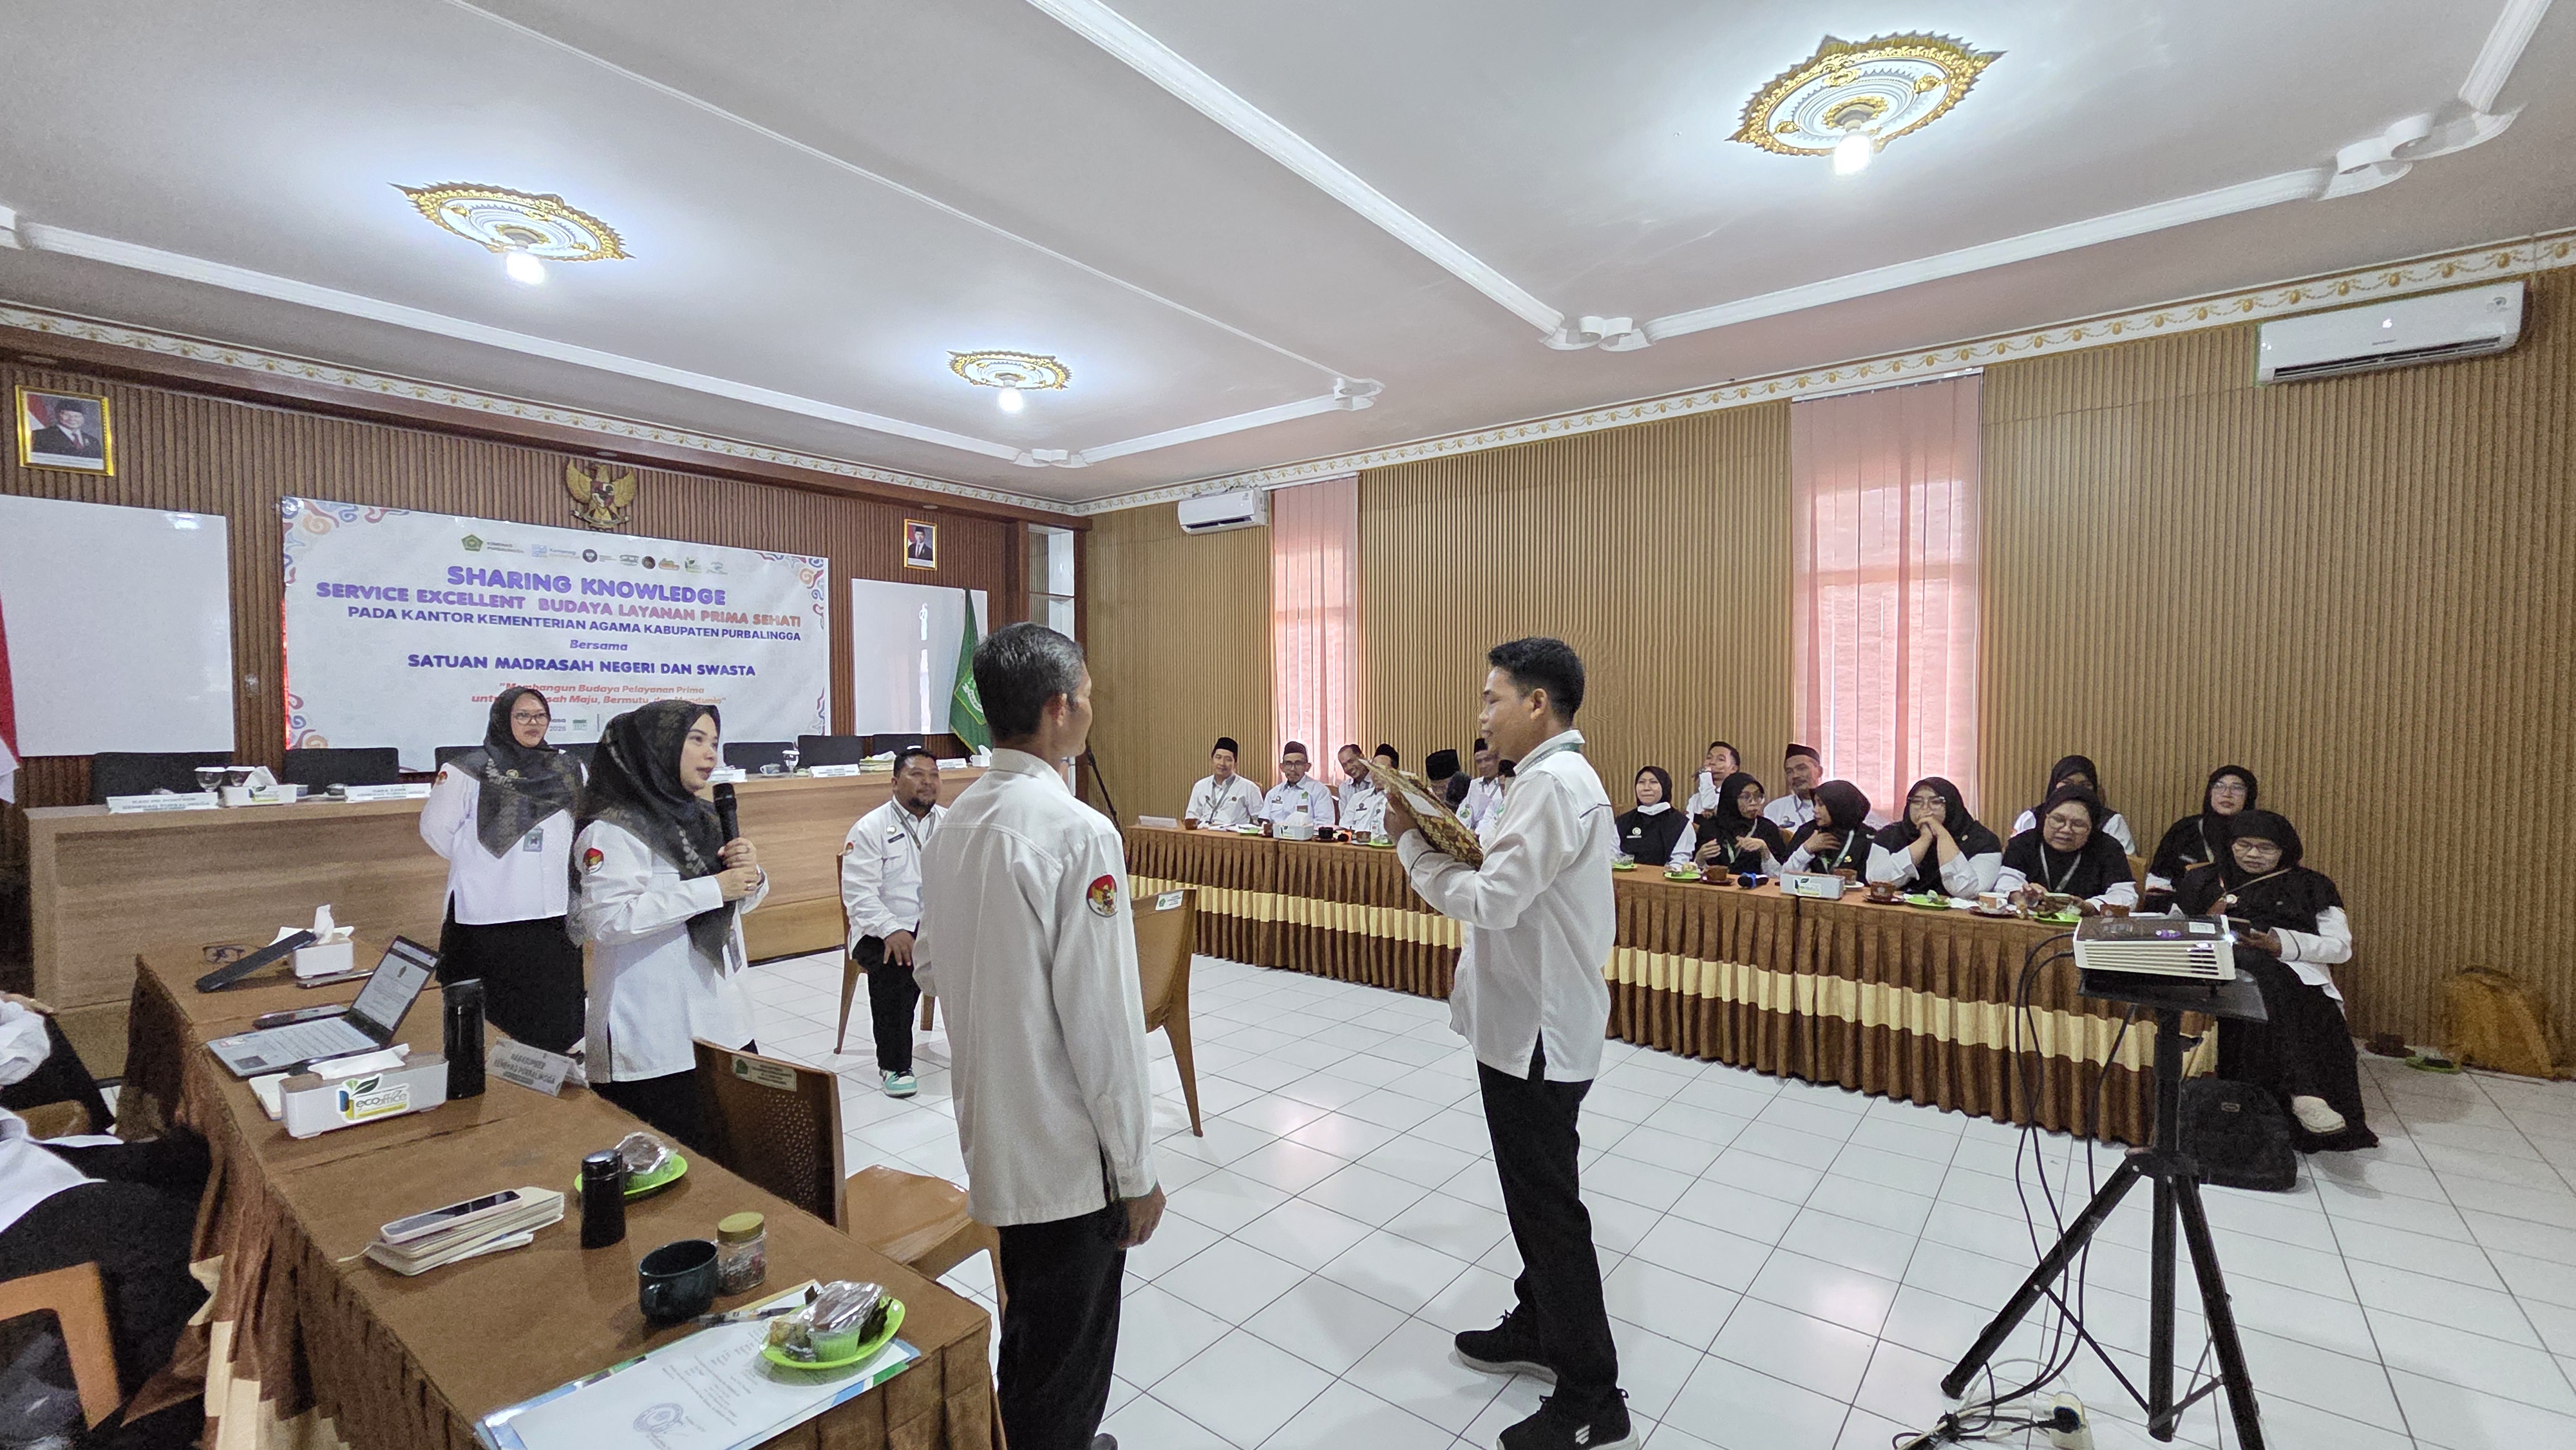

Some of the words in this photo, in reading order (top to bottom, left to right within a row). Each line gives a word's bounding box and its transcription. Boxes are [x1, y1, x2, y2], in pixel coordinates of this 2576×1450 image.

[448, 566, 571, 593] SHARING
[581, 578, 726, 606] KNOWLEDGE
[316, 582, 409, 602] SERVICE
[417, 589, 526, 609] EXCELLENT
[538, 598, 612, 616] BUDAYA
[618, 604, 695, 621] LAYANAN
[701, 610, 748, 625] PRIMA
[753, 614, 801, 627] SEHATI
[348, 606, 397, 619] PADA
[401, 609, 474, 623] KANTOR
[477, 614, 585, 630] KEMENTERIAN
[589, 621, 641, 634] AGAMA
[644, 625, 719, 637] KABUPATEN
[721, 629, 801, 641] PURBALINGGA
[570, 639, 628, 651] Bersama
[408, 654, 488, 668] SATUAN
[495, 657, 594, 672] MADRASAH
[600, 661, 655, 673] NEGERI
[661, 663, 692, 675] DAN
[697, 664, 756, 676] SWASTA
[569, 695, 601, 705] Maju,
[578, 684, 620, 694] Budaya
[622, 686, 674, 695] Pelayanan
